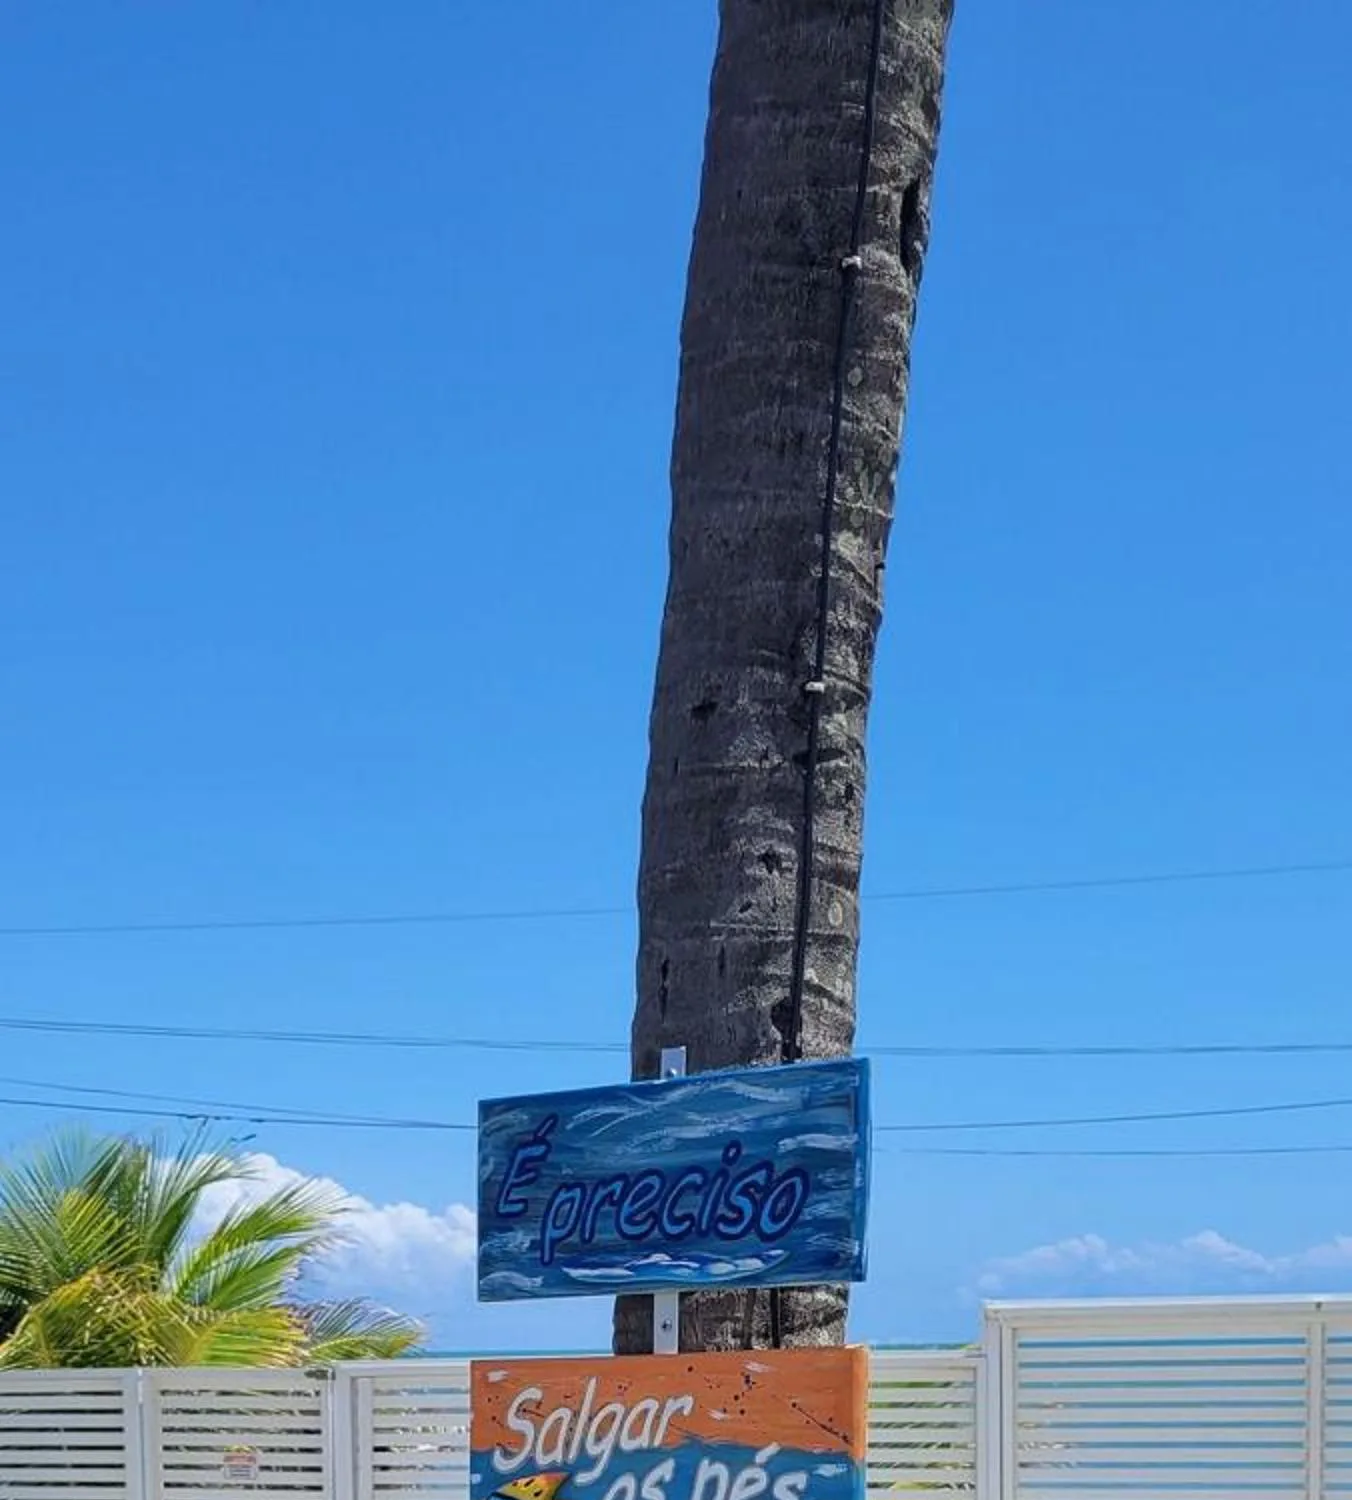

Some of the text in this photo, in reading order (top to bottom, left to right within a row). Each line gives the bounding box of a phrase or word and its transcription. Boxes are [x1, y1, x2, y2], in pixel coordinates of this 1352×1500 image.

[495, 1113, 810, 1264] É preciso
[492, 1377, 694, 1485] Salgar
